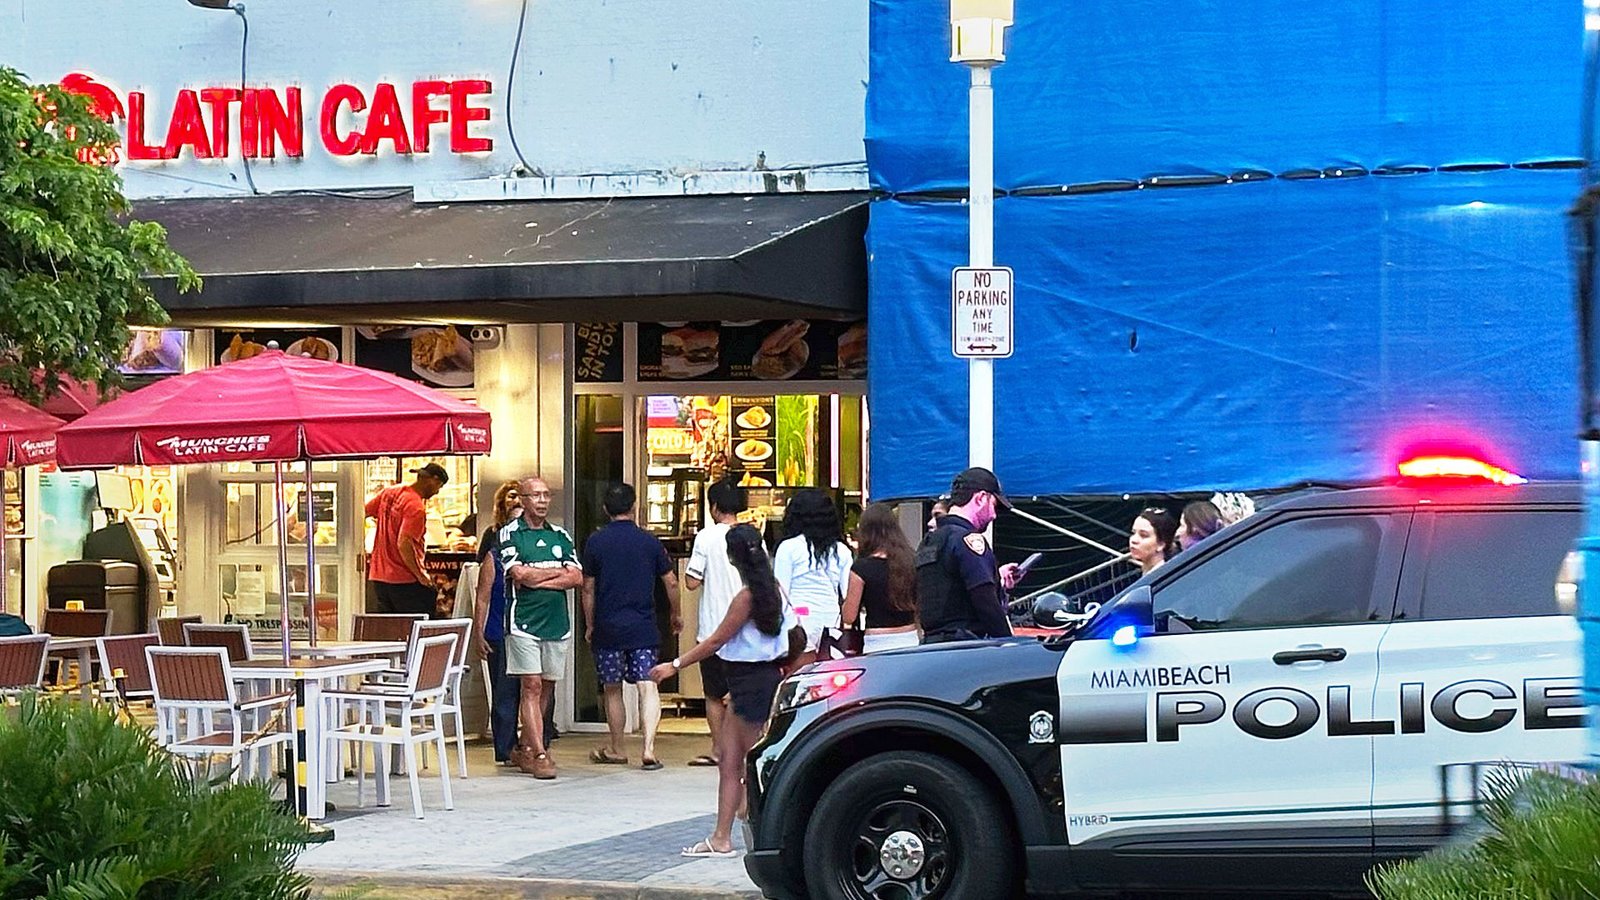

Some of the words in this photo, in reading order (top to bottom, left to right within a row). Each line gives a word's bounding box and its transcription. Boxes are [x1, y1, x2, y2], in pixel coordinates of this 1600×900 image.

[127, 87, 303, 161] LATIN
[320, 80, 493, 156] CAFE
[973, 272, 992, 288] NO
[958, 290, 1008, 306] PARKING
[972, 308, 993, 320] ANY
[972, 322, 993, 334] TIME
[590, 359, 606, 379] IN
[169, 435, 271, 449] MUNCHIES
[174, 444, 219, 456] LATIN
[224, 443, 266, 453] CAFE
[425, 561, 458, 570] LWAYS
[1156, 677, 1592, 743] POLICE
[1069, 814, 1109, 827] HYBRID
